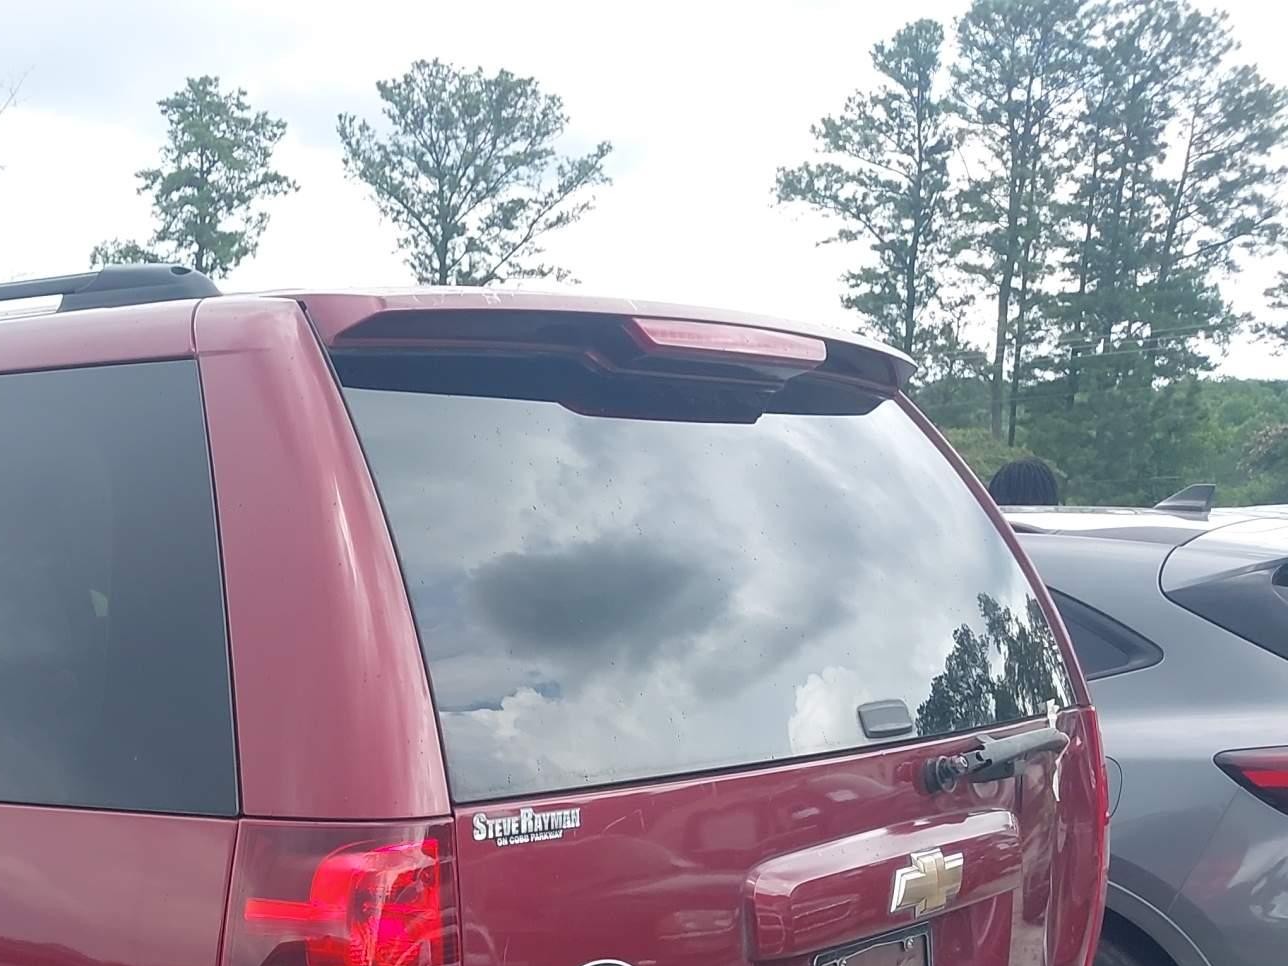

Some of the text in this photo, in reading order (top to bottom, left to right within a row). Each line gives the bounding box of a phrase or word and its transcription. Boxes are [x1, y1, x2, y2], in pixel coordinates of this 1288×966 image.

[473, 807, 581, 841] STEVE RAYMAN
[497, 830, 563, 847] ON COBB PARKWAY
